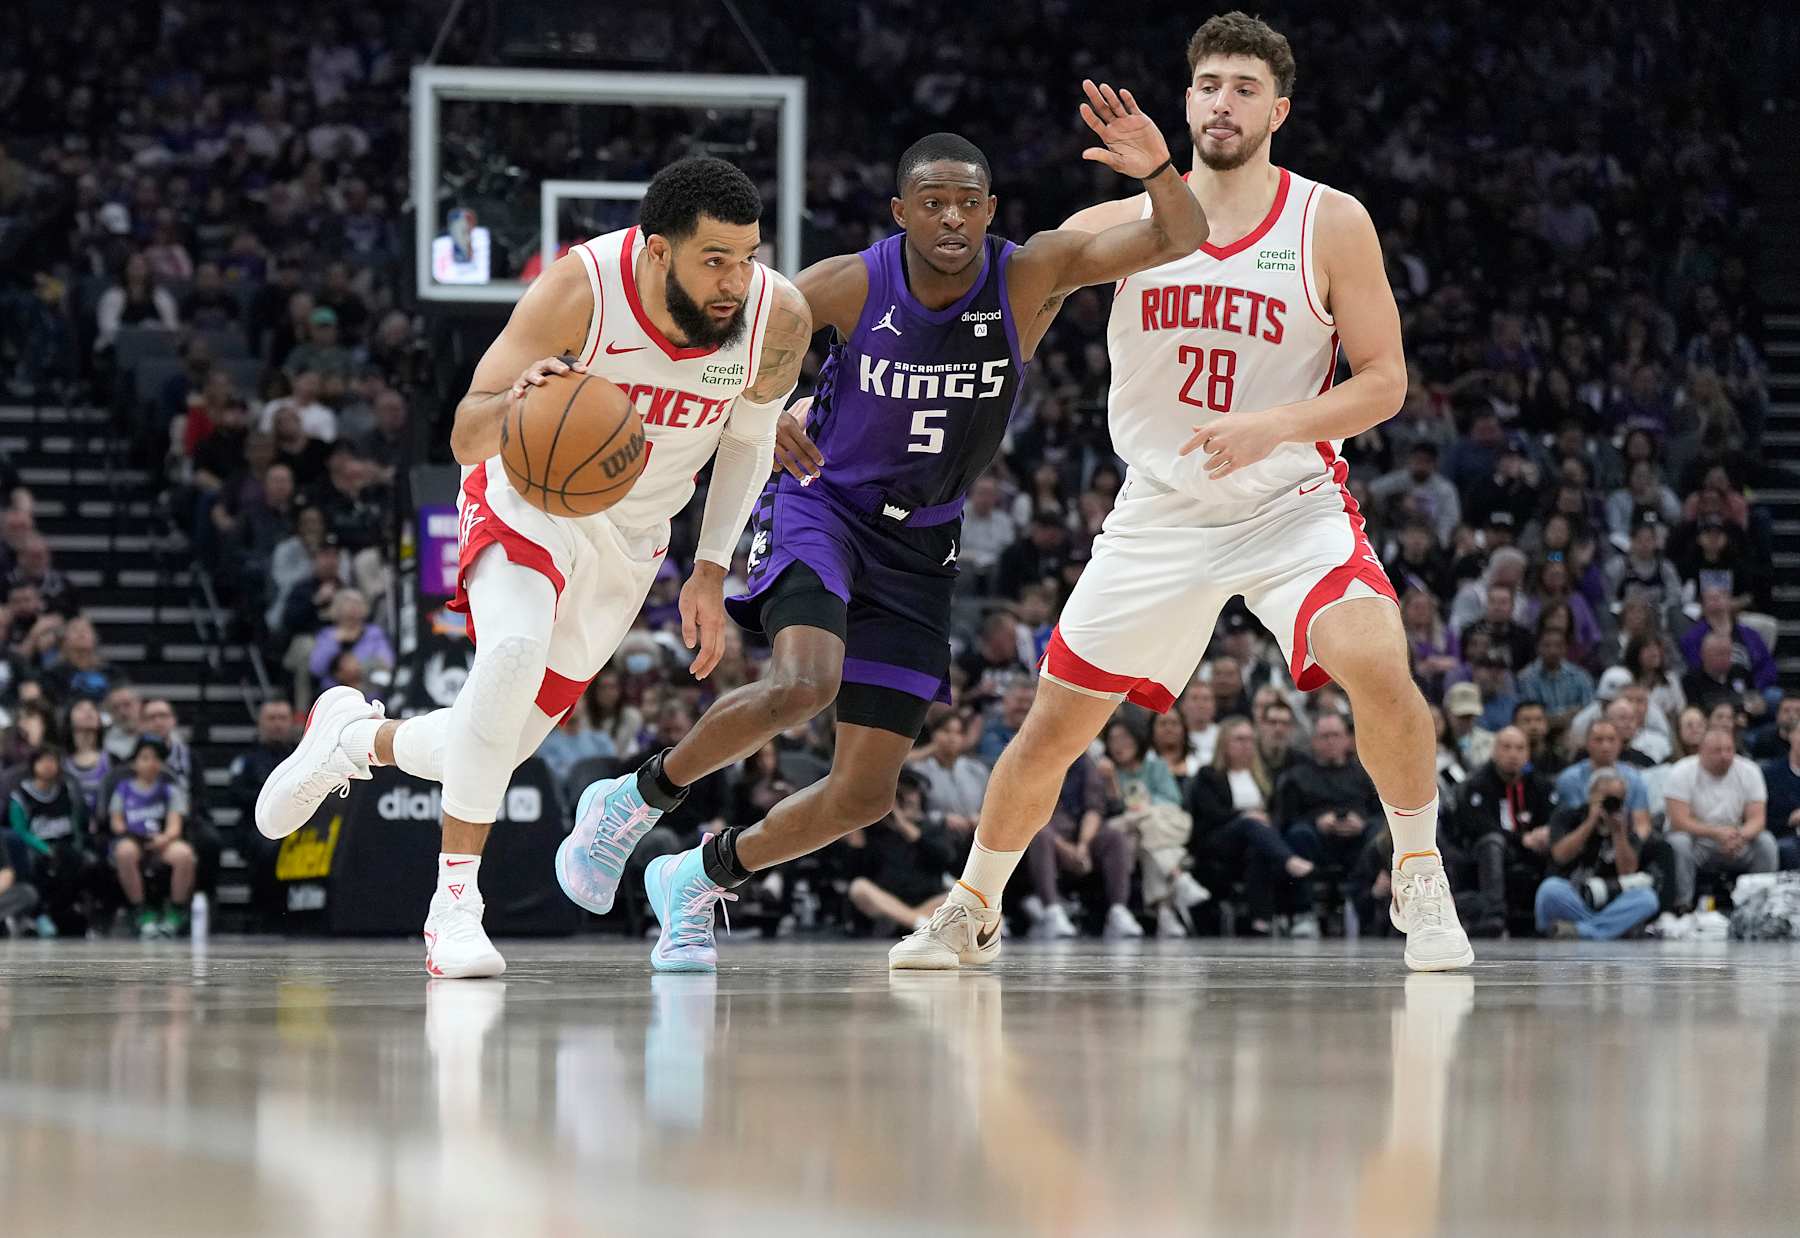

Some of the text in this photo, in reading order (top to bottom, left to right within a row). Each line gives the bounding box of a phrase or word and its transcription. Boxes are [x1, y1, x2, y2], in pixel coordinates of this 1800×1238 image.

[1259, 249, 1296, 260] credit
[1257, 259, 1296, 271] karma
[961, 309, 1002, 324] dialpad
[1141, 284, 1287, 345] ROCKETS
[706, 363, 745, 374] credit
[894, 361, 977, 373] SACRAMENTO
[702, 373, 742, 386] karma
[1178, 345, 1237, 412] 28
[615, 383, 731, 428] CKETS
[907, 410, 947, 454] 5
